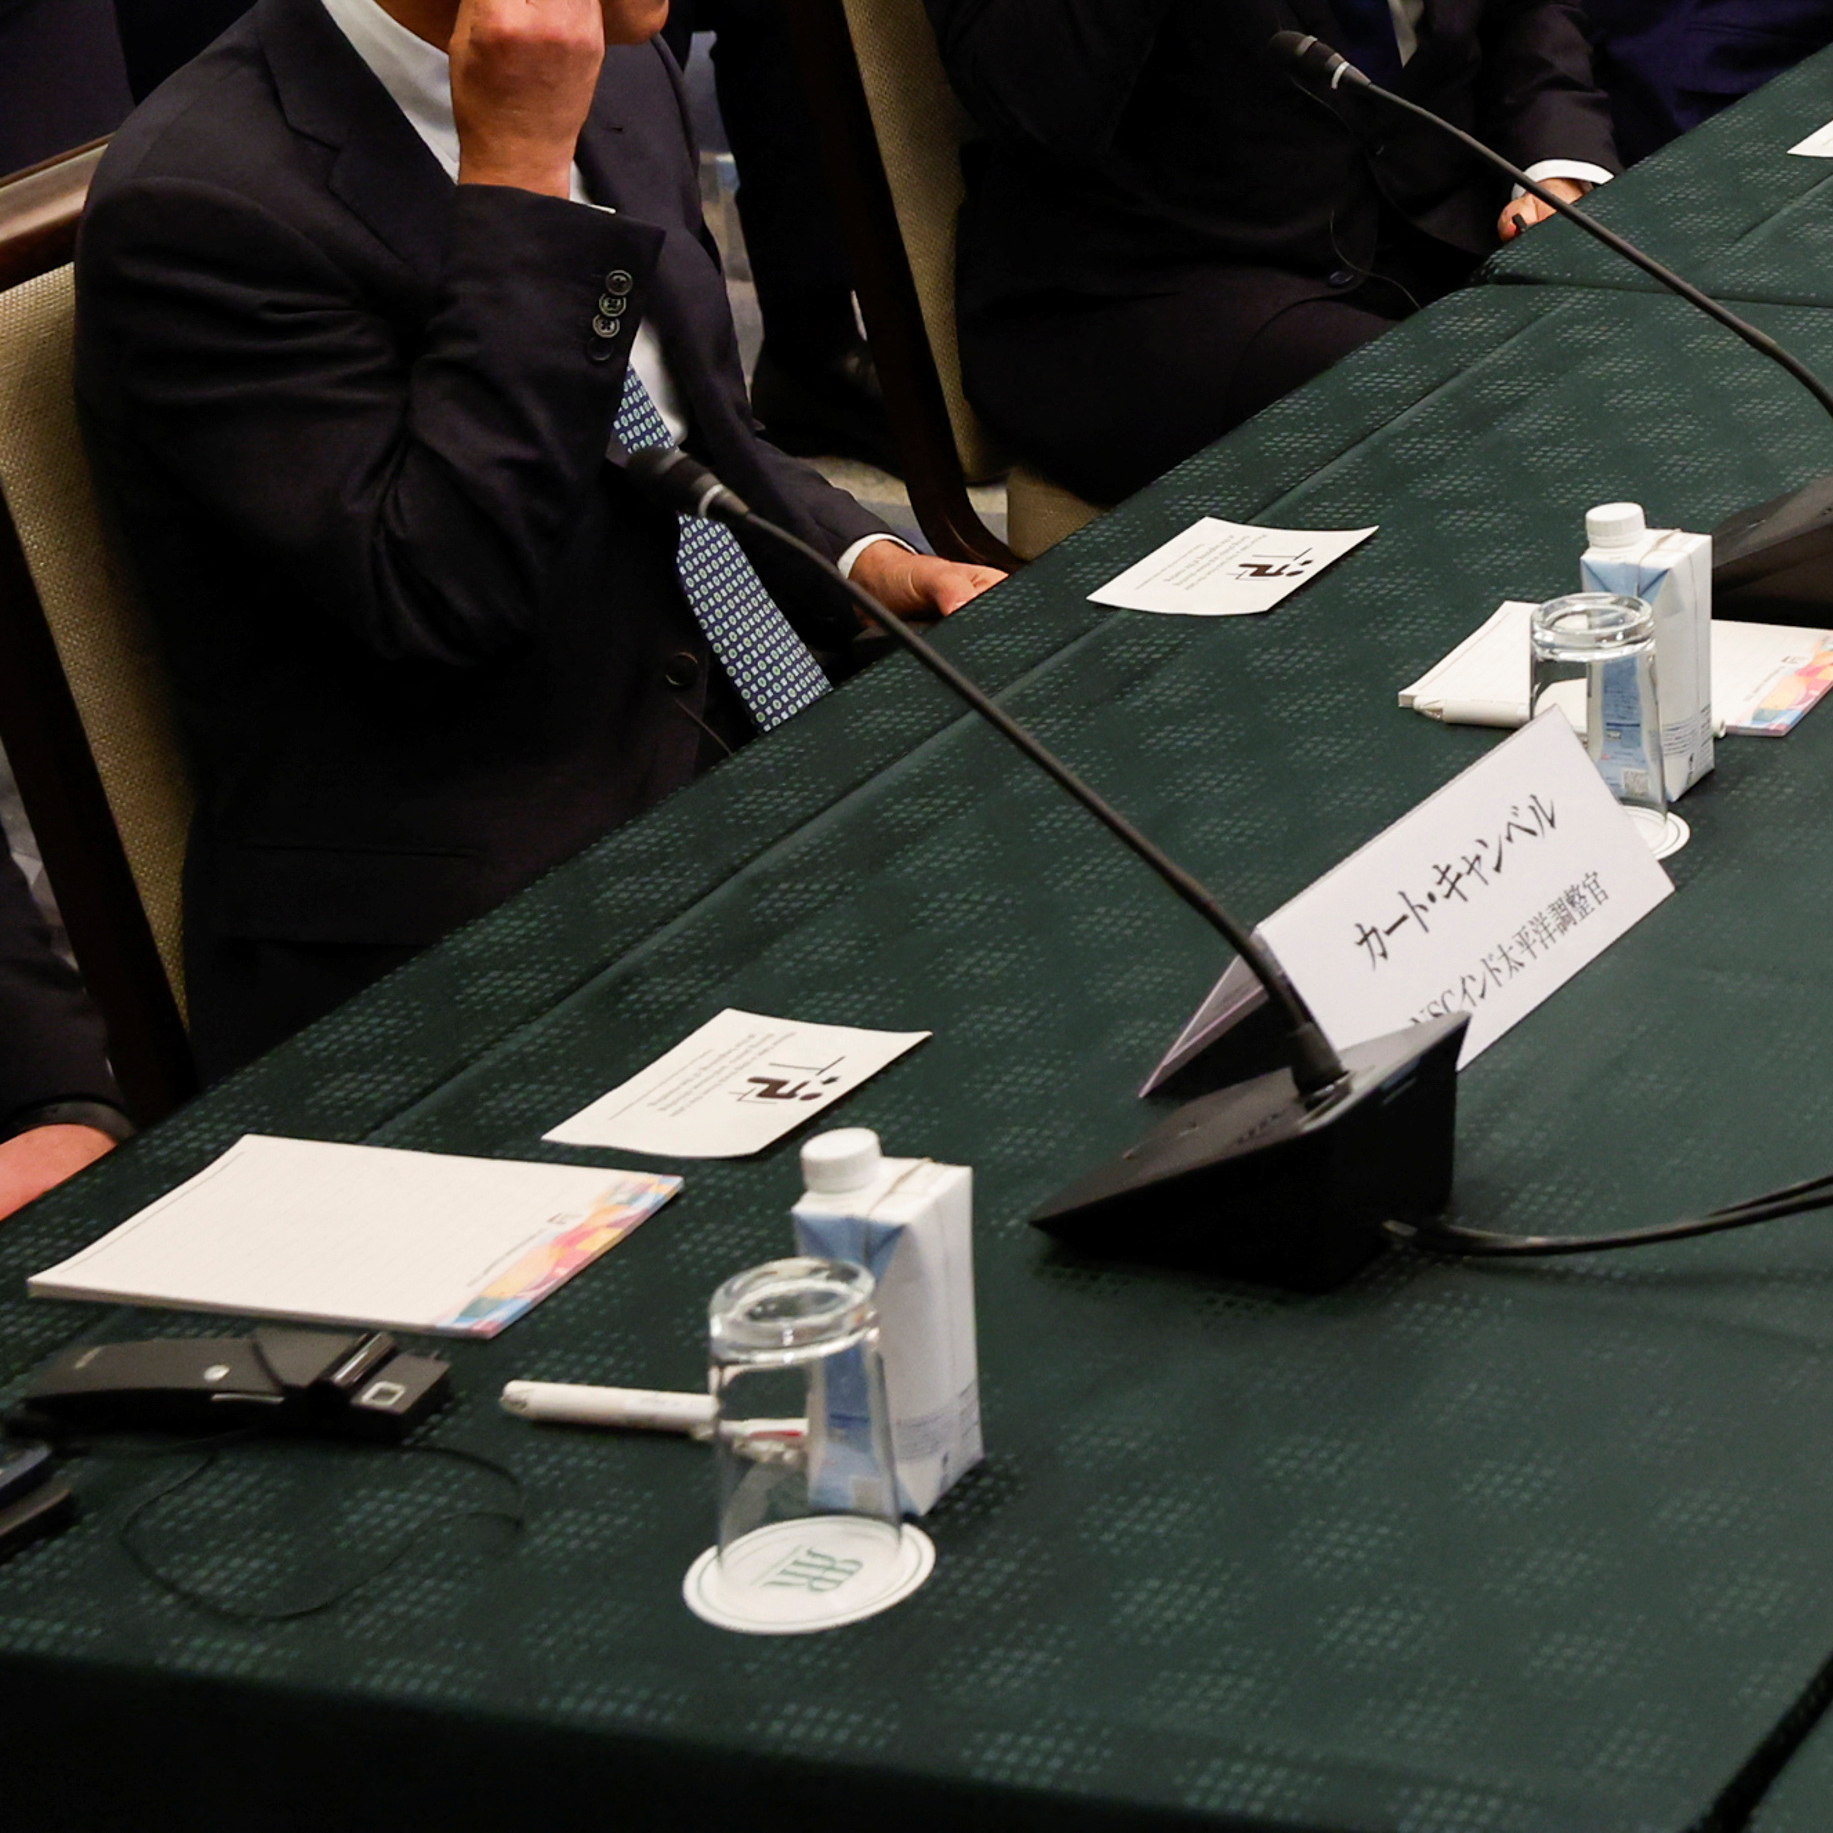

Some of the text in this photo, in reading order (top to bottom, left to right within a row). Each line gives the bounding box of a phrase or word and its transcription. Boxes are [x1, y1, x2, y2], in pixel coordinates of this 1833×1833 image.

[1355, 793, 1560, 971] カート・キャンベル
[1409, 871, 1611, 1025] SCインド太平洋調整官
